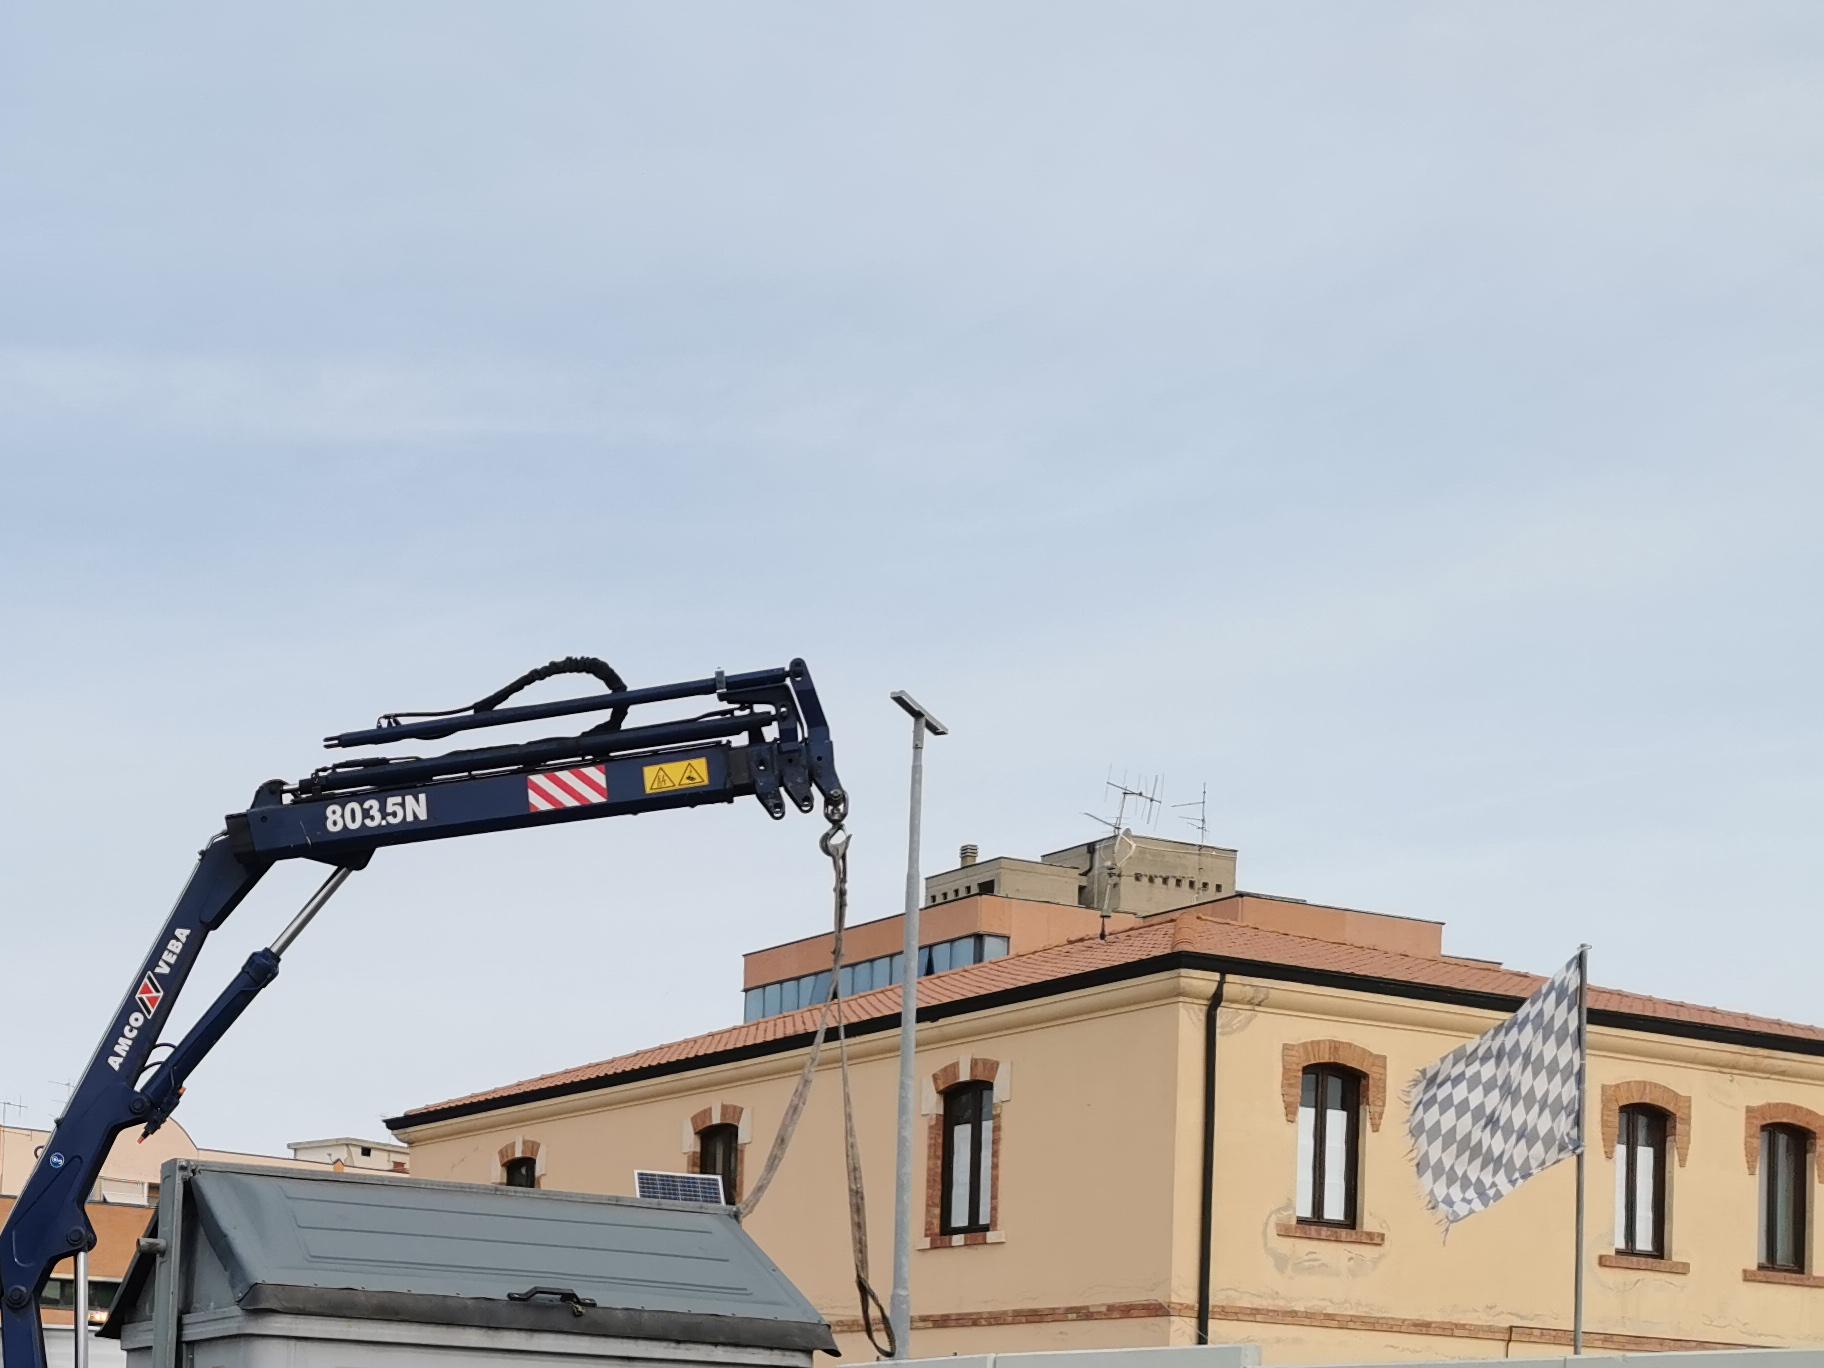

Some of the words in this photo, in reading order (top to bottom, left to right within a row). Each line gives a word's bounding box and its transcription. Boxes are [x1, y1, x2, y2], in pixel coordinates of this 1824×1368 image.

[325, 792, 428, 832] 803.5N
[107, 1011, 145, 1072] AMCO
[153, 927, 192, 975] VEBA
